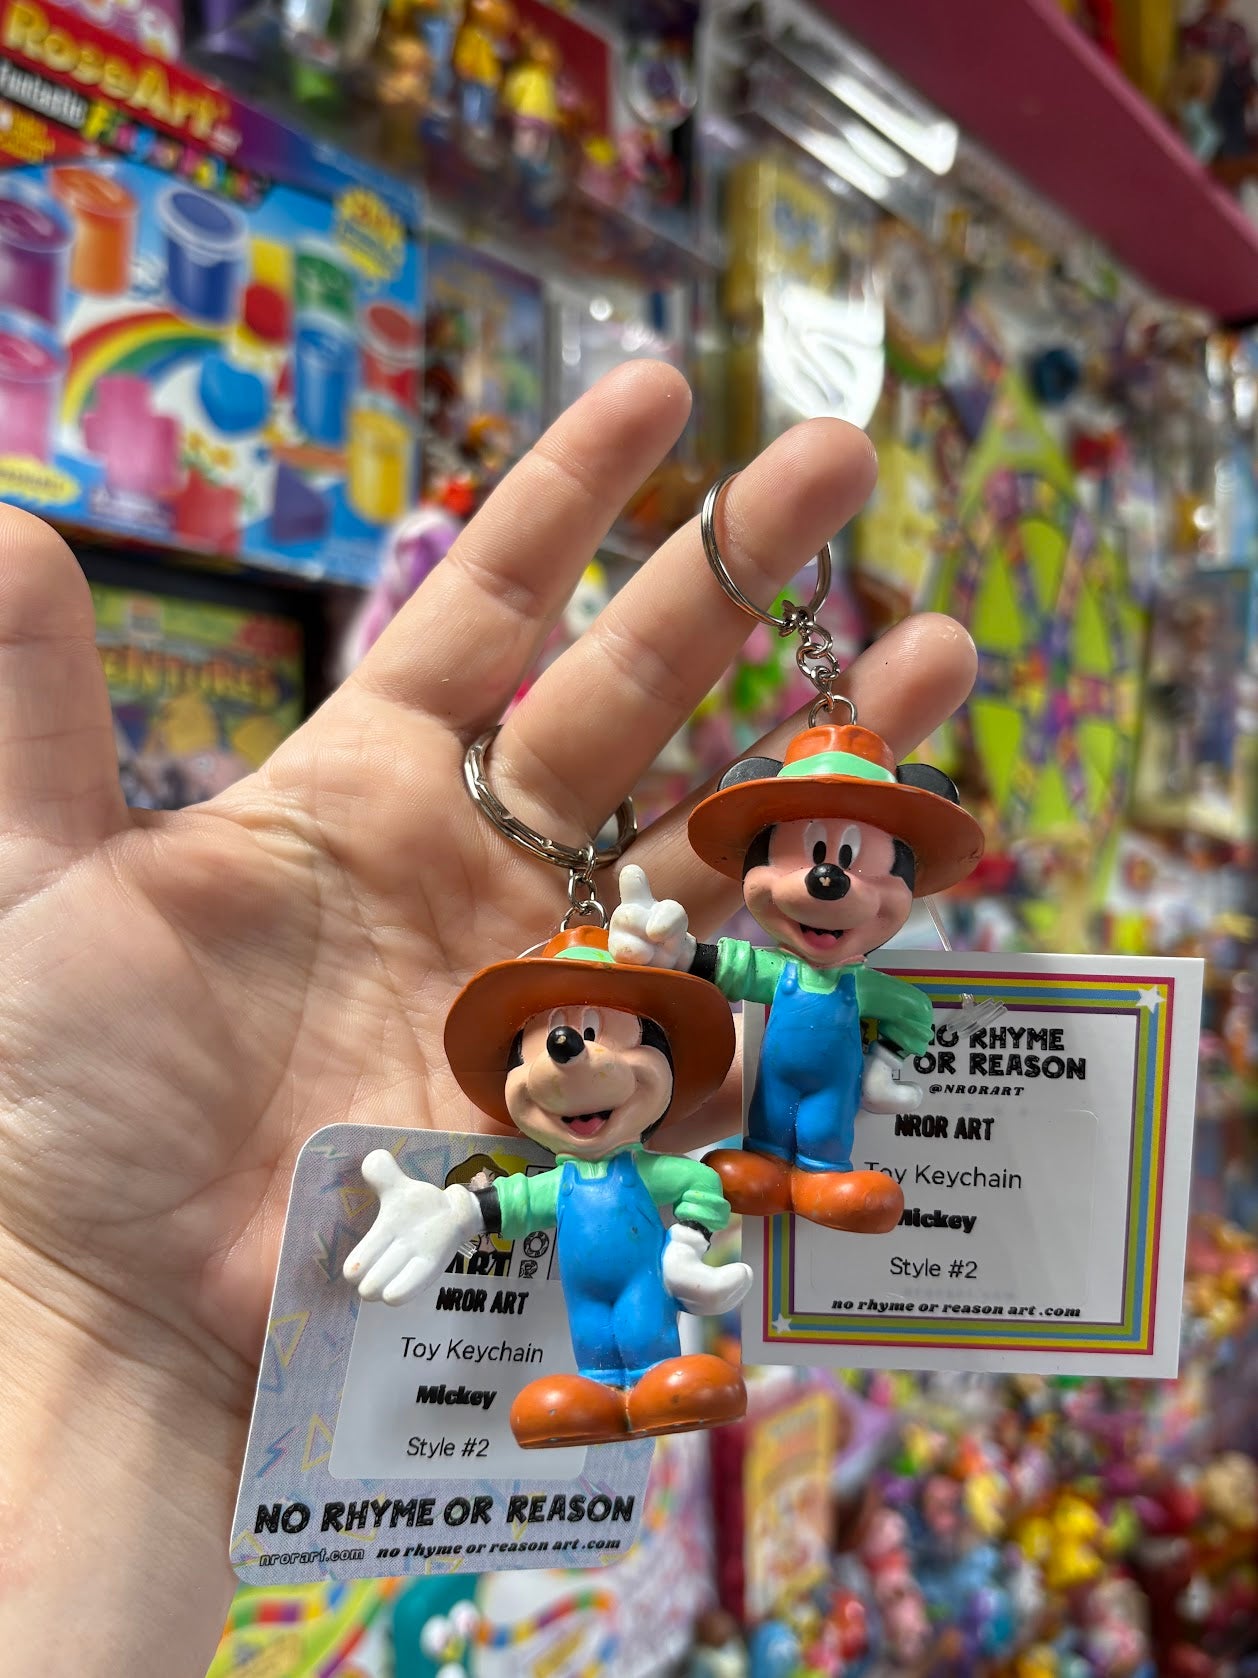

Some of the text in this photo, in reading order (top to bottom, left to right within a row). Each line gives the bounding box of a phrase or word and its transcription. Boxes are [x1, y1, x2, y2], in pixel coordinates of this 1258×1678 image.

[928, 1023, 1064, 1051] O RHYME
[913, 1051, 1086, 1080] OR REASON
[929, 1084, 1024, 1096] @NRORART
[895, 1113, 995, 1141] NROR ART
[915, 1164, 1022, 1189] Keychain
[890, 1256, 978, 1279] Style #2
[436, 1287, 529, 1315] NROR ART
[832, 1299, 1081, 1318] no rhyme or reason art .com
[401, 1336, 544, 1363] Toy Keychain
[416, 1384, 497, 1410] Mickey
[407, 1436, 490, 1458] Style #2
[254, 1494, 636, 1534] NO RHYME OR REASON
[259, 1548, 365, 1567] nrorart.com
[376, 1538, 622, 1559] no rhyme or reason art .com
